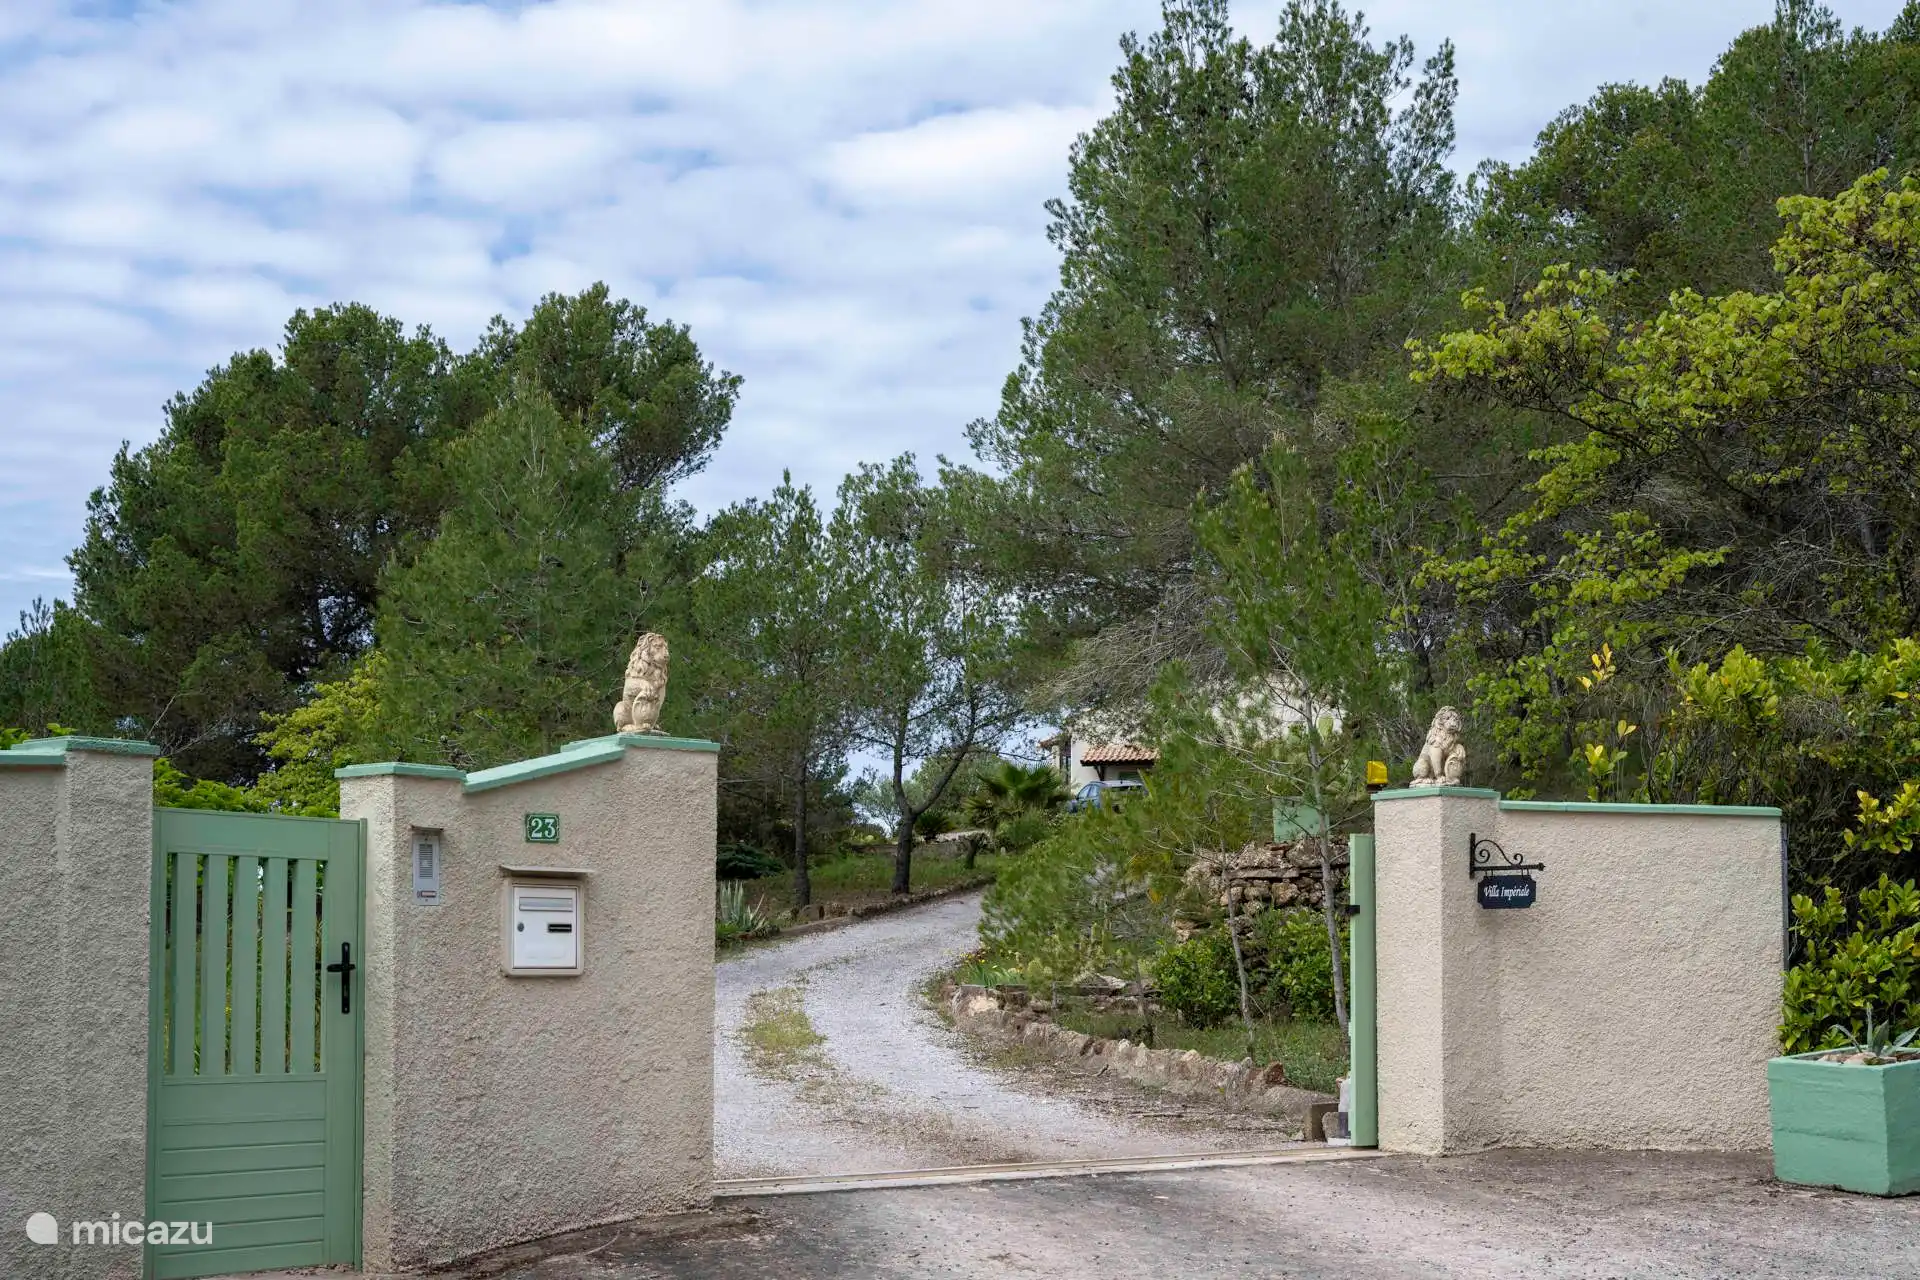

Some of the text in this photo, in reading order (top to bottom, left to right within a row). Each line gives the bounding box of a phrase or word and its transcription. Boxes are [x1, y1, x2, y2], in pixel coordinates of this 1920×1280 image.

[531, 818, 556, 838] 23
[1483, 884, 1530, 901] Villa Impériale
